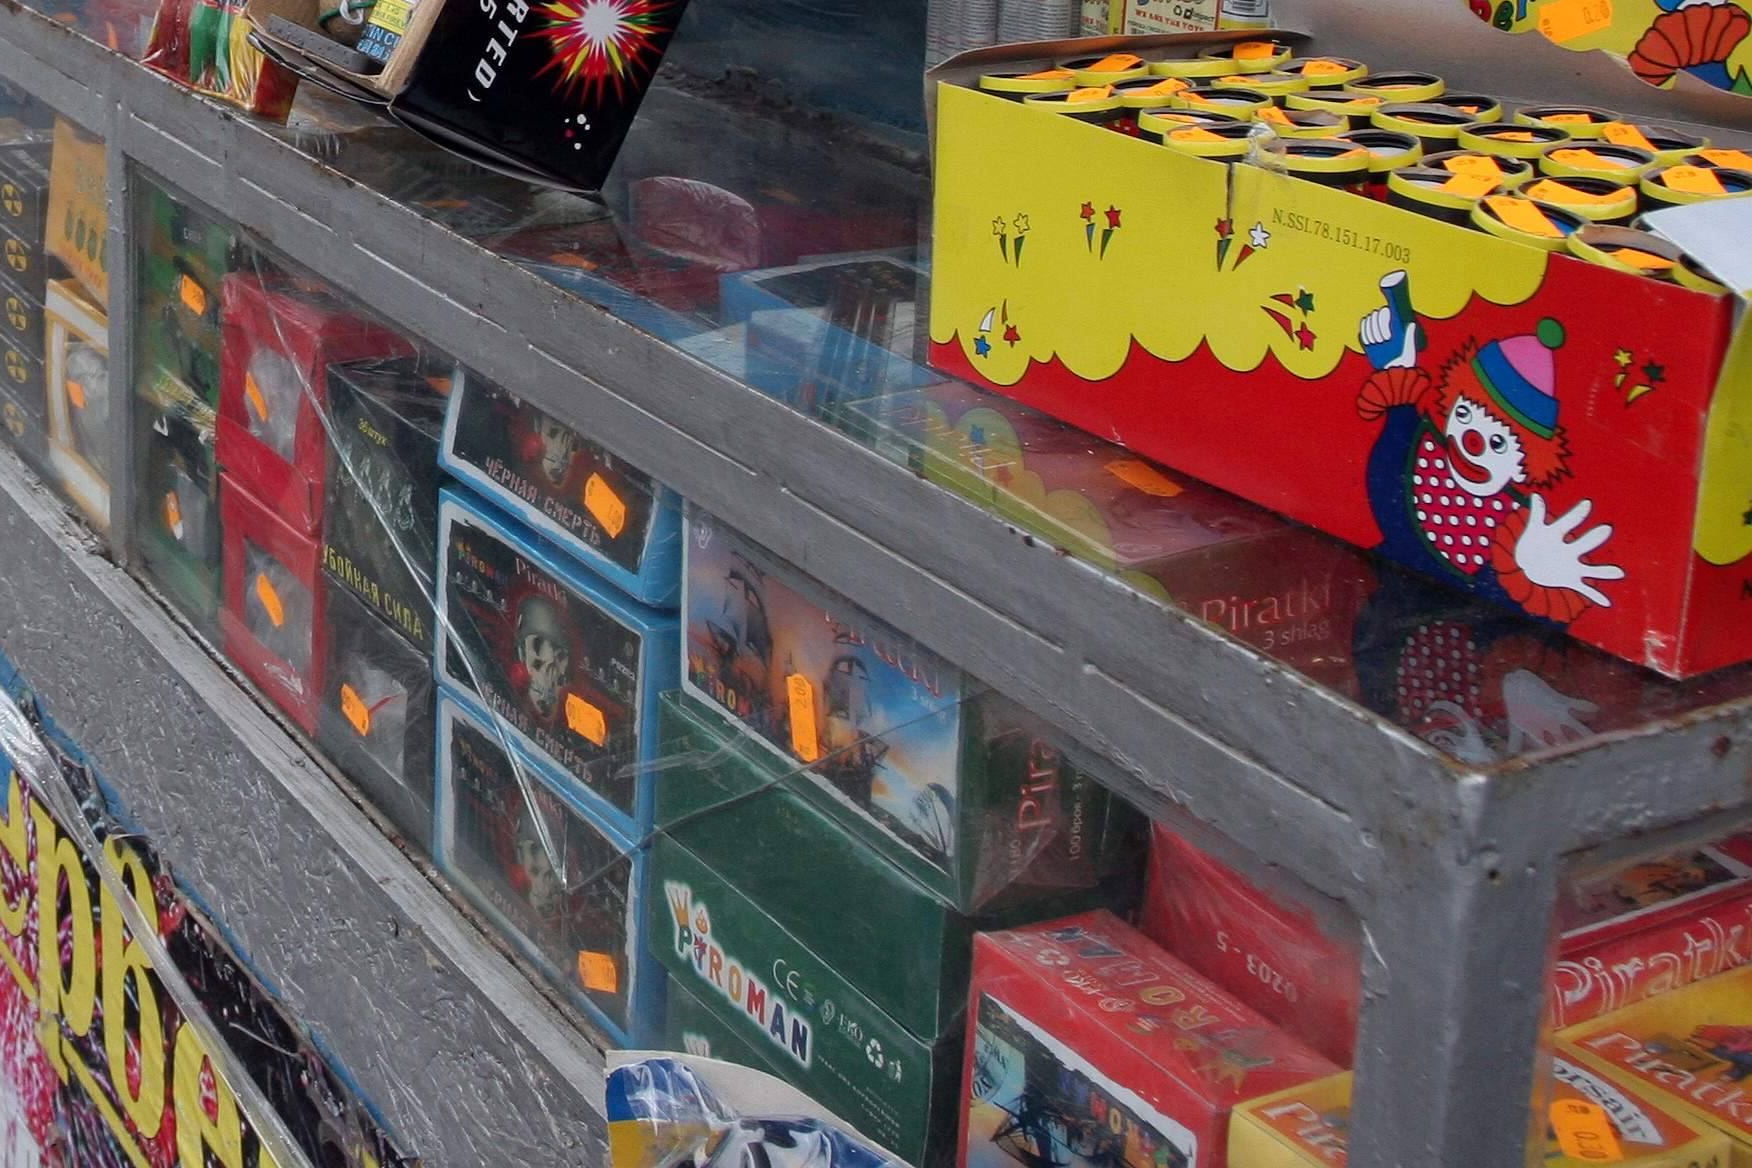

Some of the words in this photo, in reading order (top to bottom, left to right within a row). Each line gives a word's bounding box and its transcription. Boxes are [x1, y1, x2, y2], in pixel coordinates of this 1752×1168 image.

[321, 543, 381, 608] УБОЙНАЯ
[383, 591, 425, 641] СИЛА
[1263, 630, 1275, 651] 3
